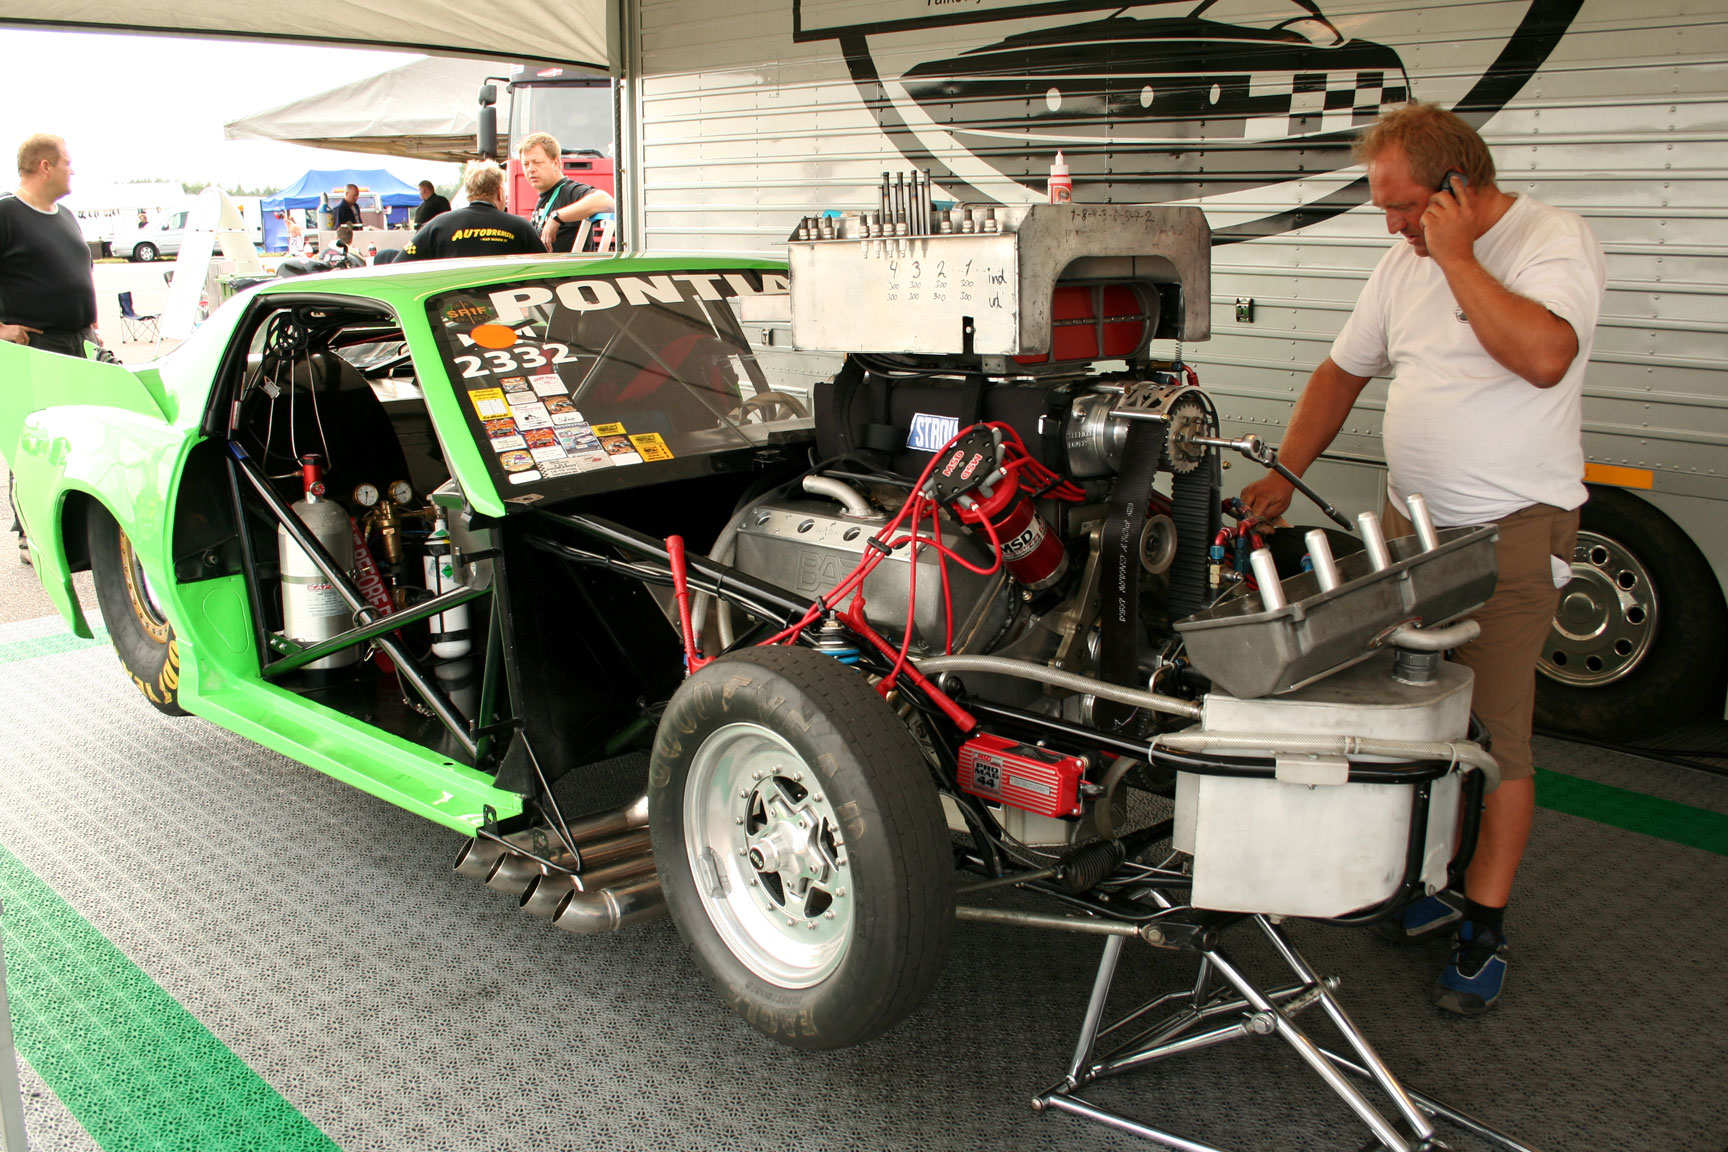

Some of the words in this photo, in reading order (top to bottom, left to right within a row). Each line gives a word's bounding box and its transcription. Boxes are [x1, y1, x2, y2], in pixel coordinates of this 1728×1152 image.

[889, 259, 898, 279] 4
[911, 260, 921, 279] 3
[936, 260, 946, 278] 2
[986, 267, 1007, 285] ind
[453, 342, 578, 379] 2332
[943, 450, 965, 477] MSD
[960, 453, 983, 480] MSD
[1001, 529, 1033, 553] MSD
[975, 762, 999, 774] PRO
[975, 768, 1000, 779] MAG
[976, 776, 995, 788] 44
